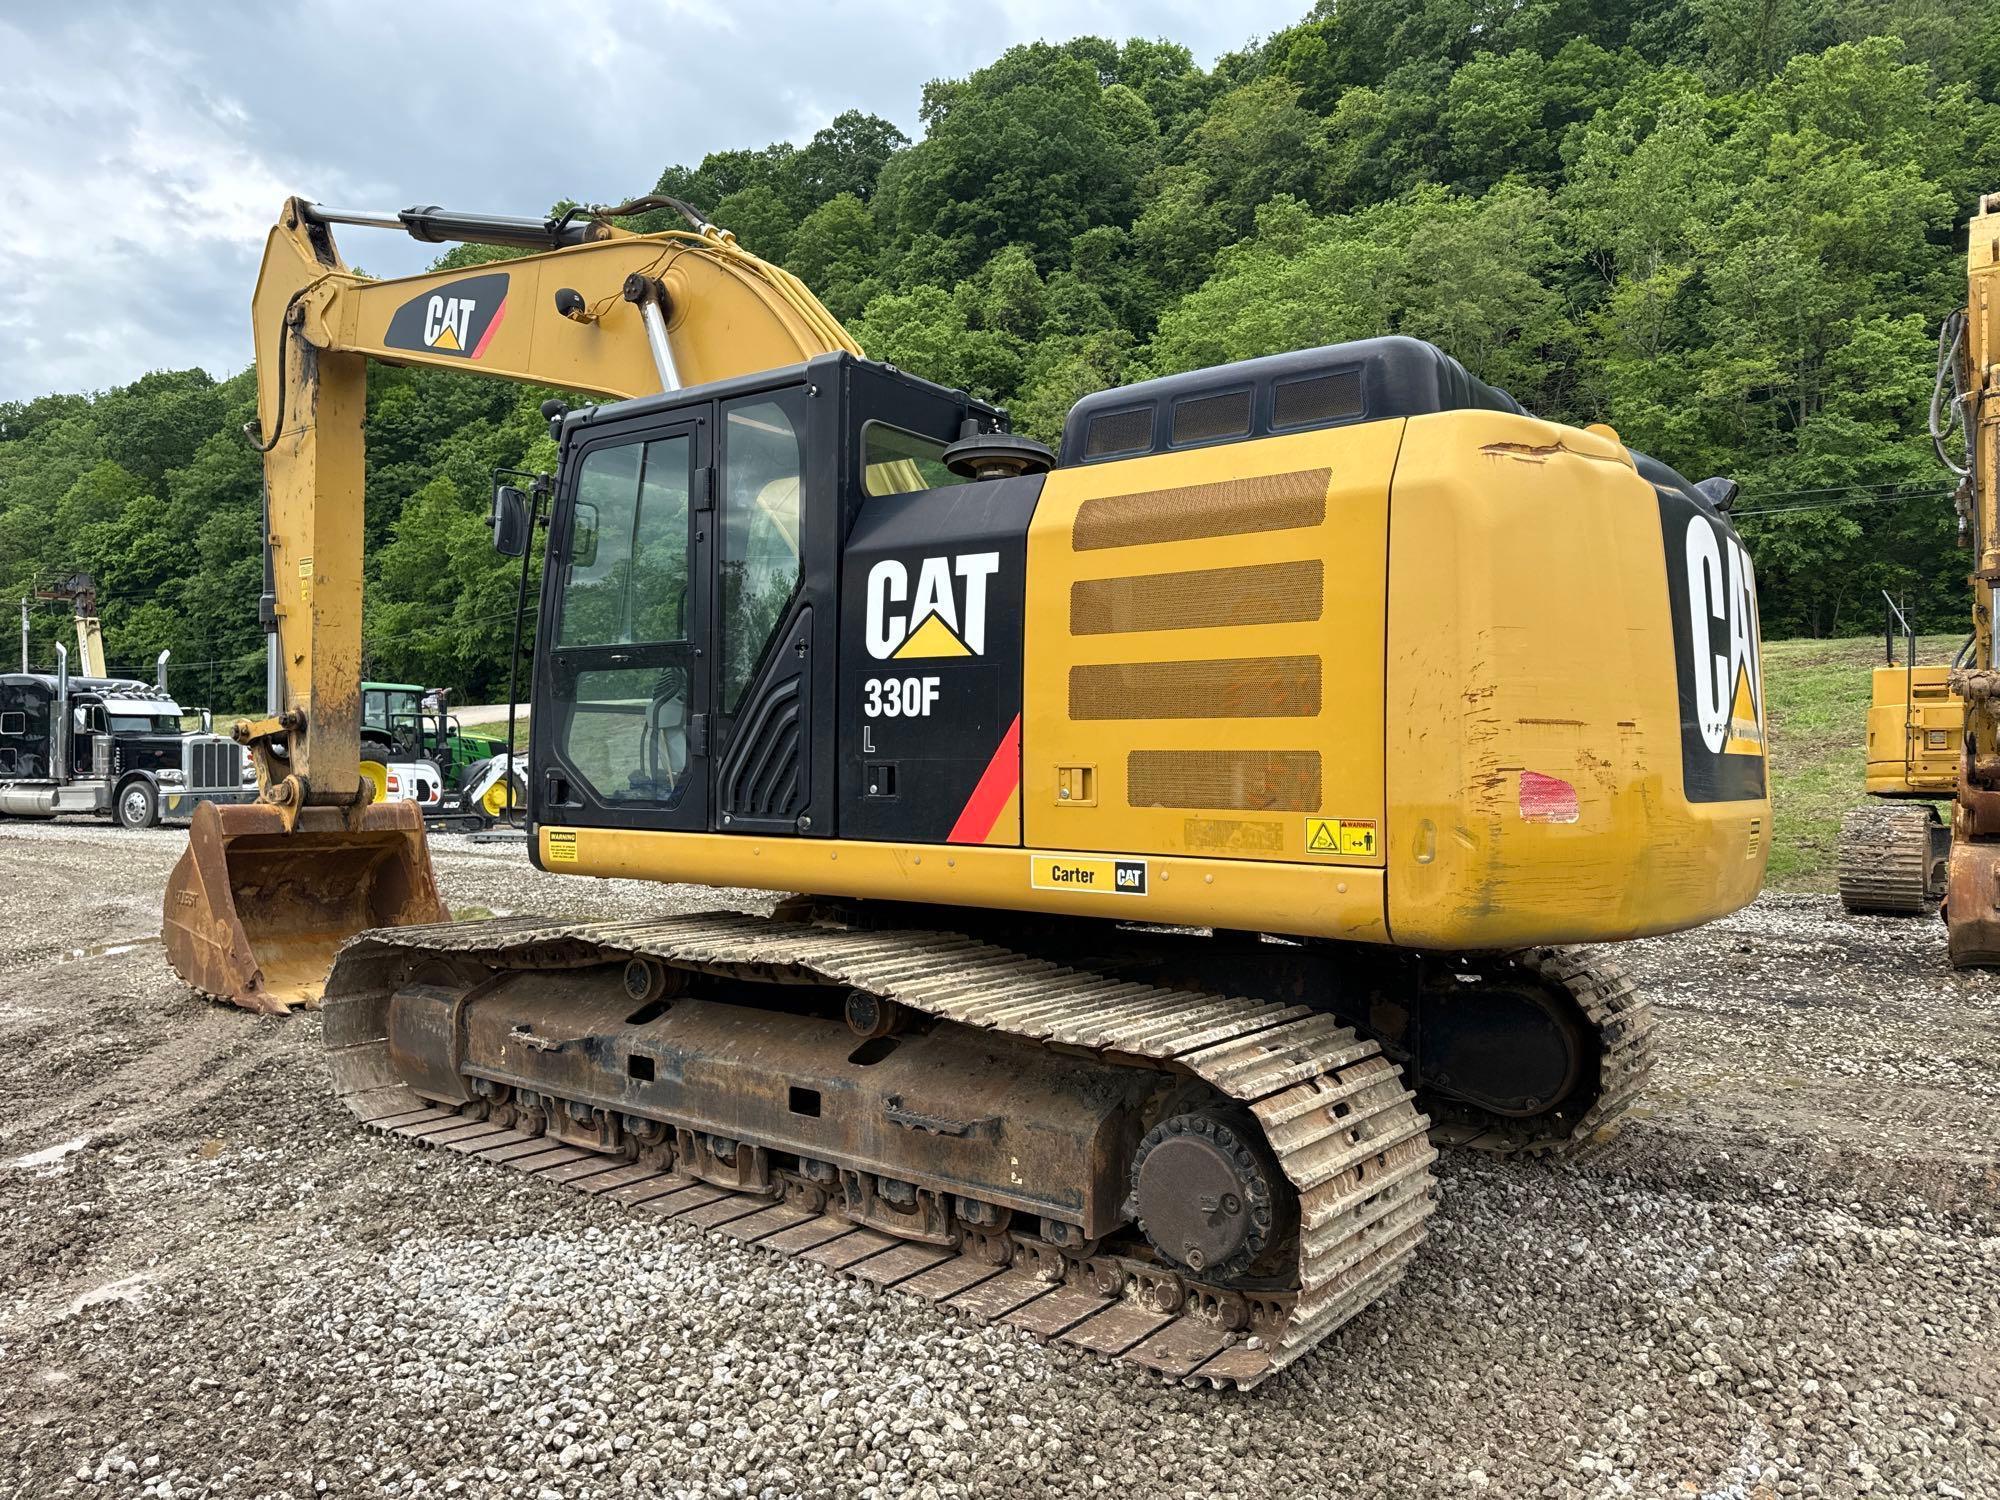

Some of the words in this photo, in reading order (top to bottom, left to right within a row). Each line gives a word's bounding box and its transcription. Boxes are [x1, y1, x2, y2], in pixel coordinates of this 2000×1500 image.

[423, 295, 476, 350] CAT
[865, 552, 999, 660] CAT
[1686, 515, 1763, 754] CAT
[864, 677, 940, 718] 330F
[863, 725, 876, 753] L
[550, 833, 576, 841] WARNING
[1052, 865, 1095, 884] Carter
[1116, 868, 1143, 887] CAT
